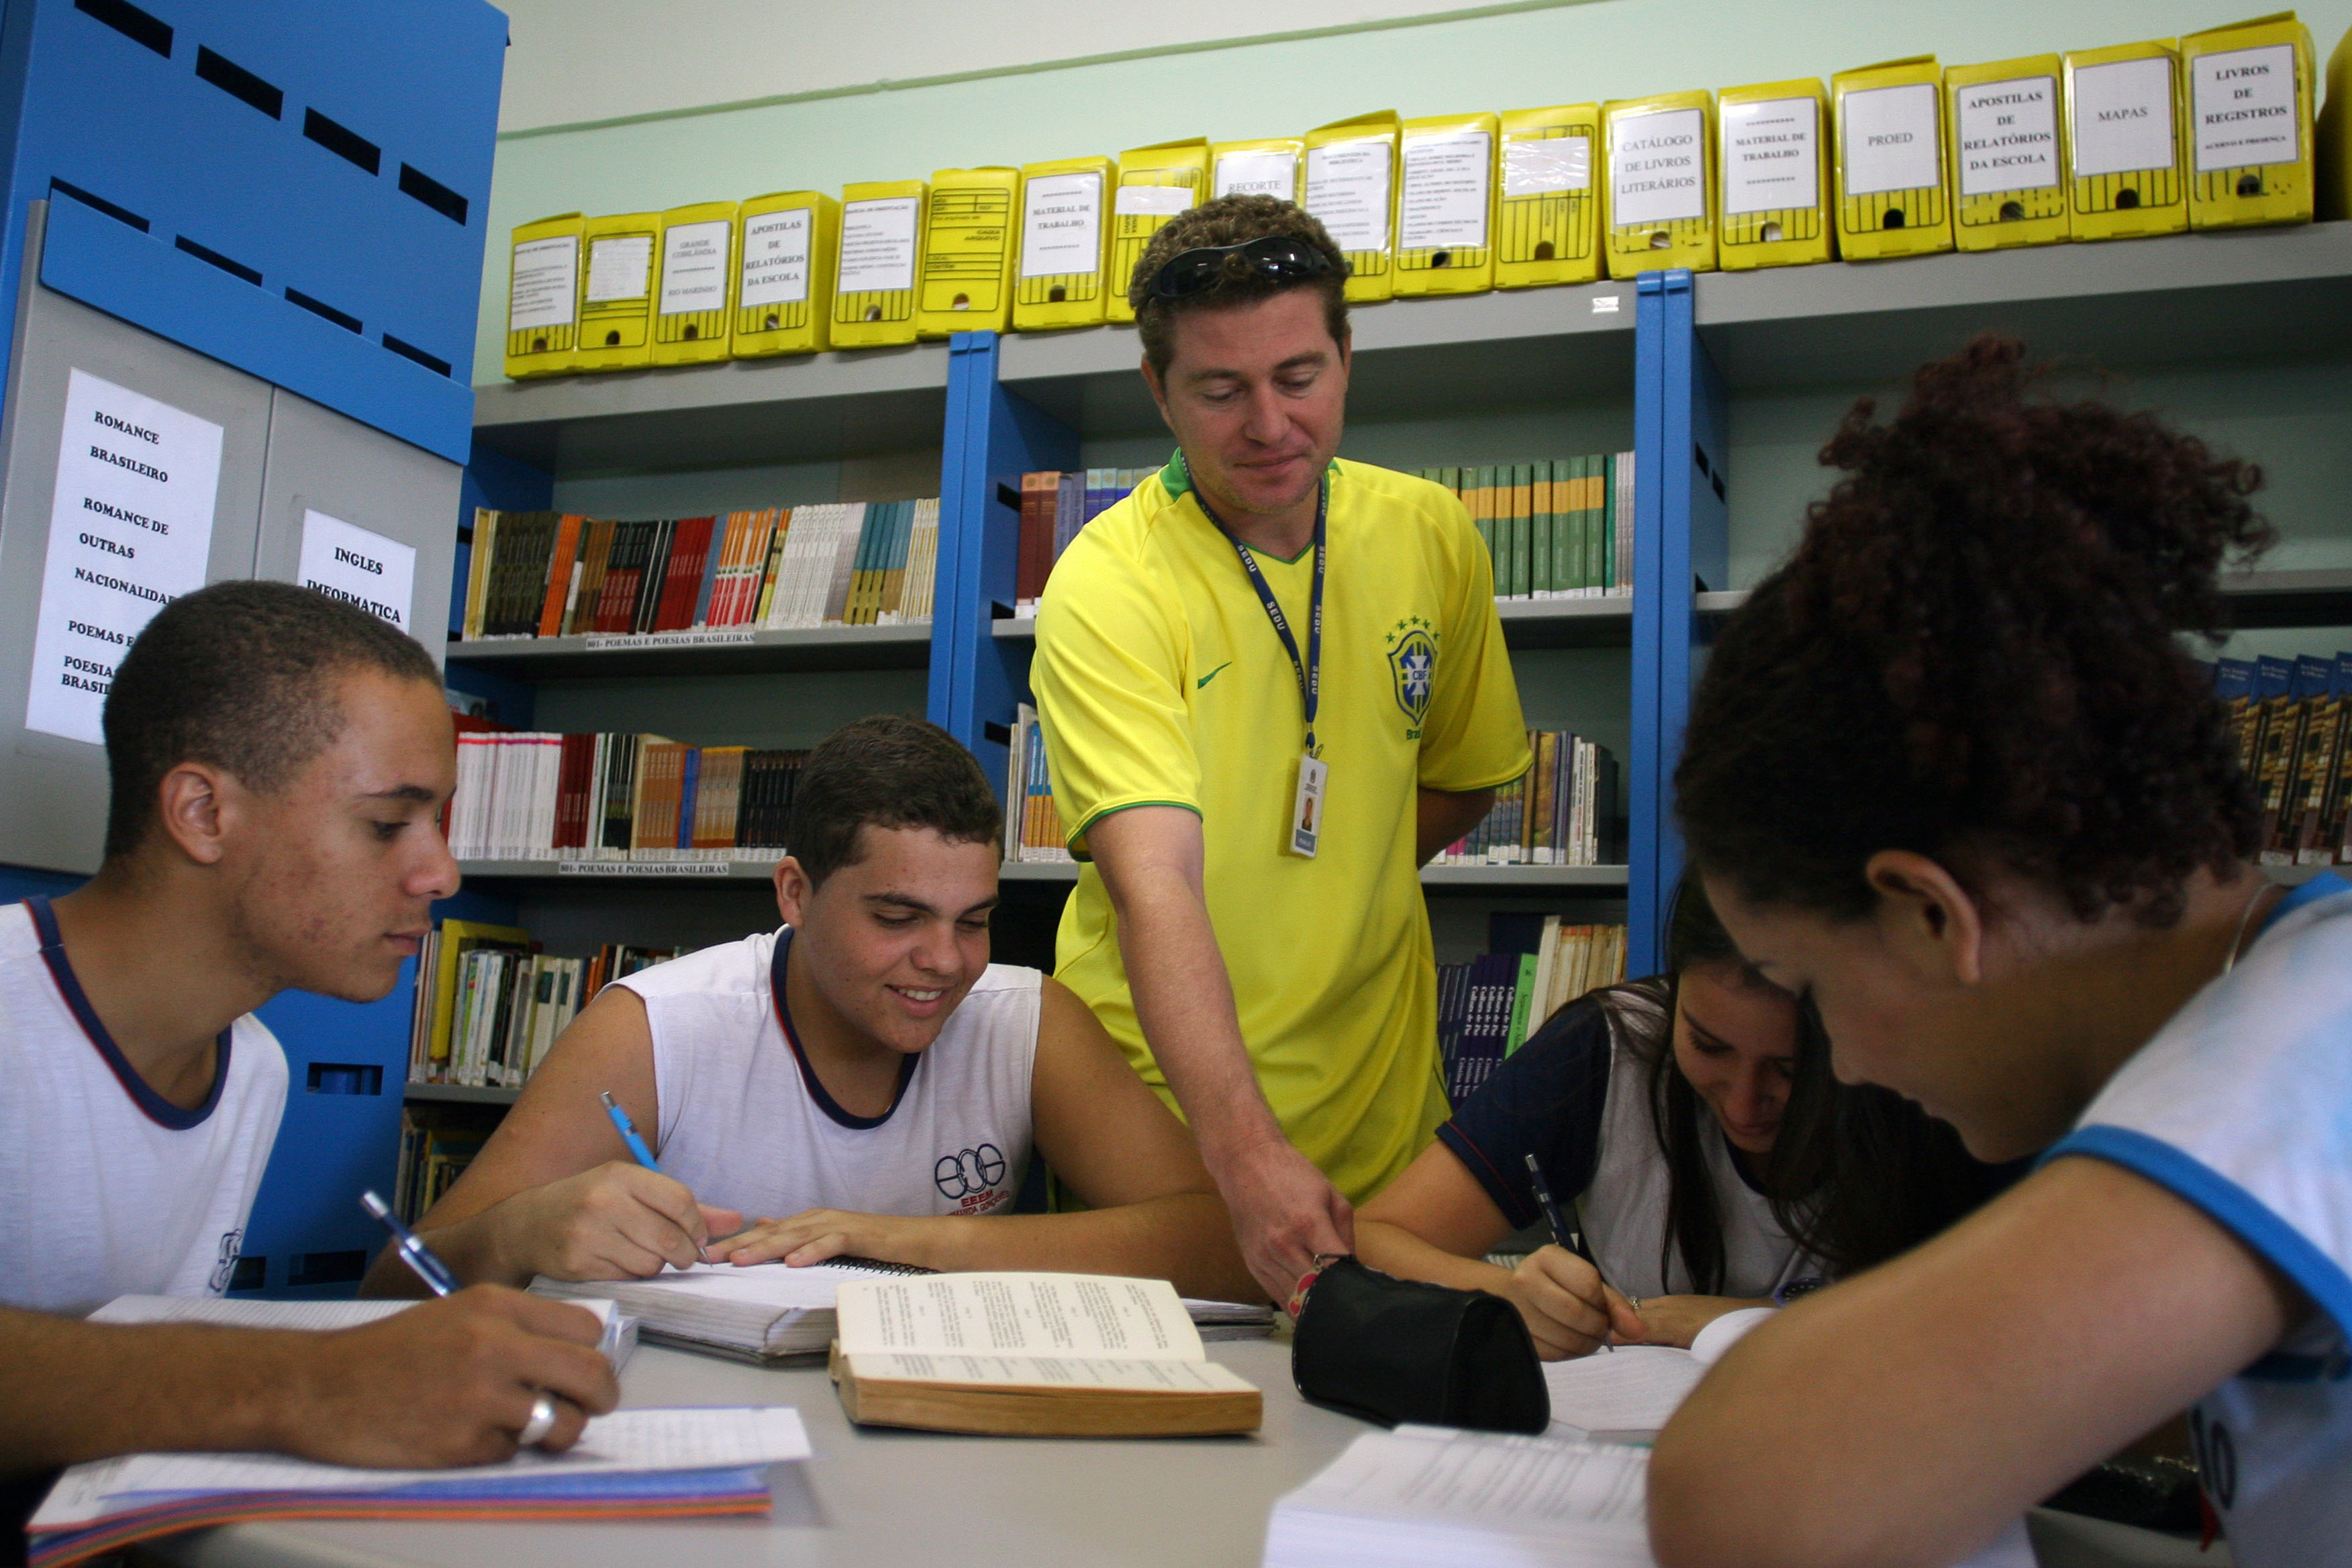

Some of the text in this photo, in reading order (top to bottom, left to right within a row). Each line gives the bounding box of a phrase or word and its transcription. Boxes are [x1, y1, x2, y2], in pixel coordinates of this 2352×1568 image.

[2216, 64, 2269, 81] LIVROS
[1969, 91, 2043, 109] APOSTILAS
[2234, 88, 2252, 99] DE
[1998, 115, 2014, 125] DE
[2098, 107, 2148, 121] MAPAS
[2205, 105, 2288, 124] REGISTROS
[1623, 134, 1693, 151] CATÁLOGO
[1736, 133, 1806, 146] MATERIAL DE
[1868, 133, 1913, 146] PROED
[1964, 132, 2051, 150] RELATÓRIOS
[1625, 155, 1692, 173] DE LIVROS
[1743, 150, 1800, 162] TRABALHO
[1970, 154, 2046, 170] DA ESCOLA
[1228, 180, 1282, 193] RECORTE
[1622, 177, 1696, 194] LITERÁRIOS
[1032, 204, 1090, 215] MATERIAL DE
[751, 220, 802, 235] APOSTILAS
[1038, 219, 1085, 230] TRABALHO
[768, 240, 780, 249] DE
[745, 254, 804, 269] RELATÓRIOS
[747, 273, 799, 287] DA ESCOLA
[94, 411, 160, 444] ROMANCE
[90, 446, 168, 483] BRASILEIRO
[83, 497, 169, 536] ROMANCE DE
[79, 532, 136, 558] OUTRAS
[334, 547, 383, 575] INGLES
[1238, 544, 1257, 573] SEDU
[1267, 601, 1285, 630] SEDU
[68, 620, 124, 645] POEMAS
[605, 638, 642, 647] POEMAS
[644, 637, 650, 645] E
[652, 635, 691, 645] POESIAS
[693, 633, 755, 644] BRASILEIRAS
[1412, 671, 1426, 681] CBF
[578, 865, 616, 873] POEMAS
[618, 865, 624, 873] E
[626, 864, 665, 874] POESIAS
[665, 864, 728, 874] BRASILEIRAS
[961, 1189, 993, 1208] EEEM
